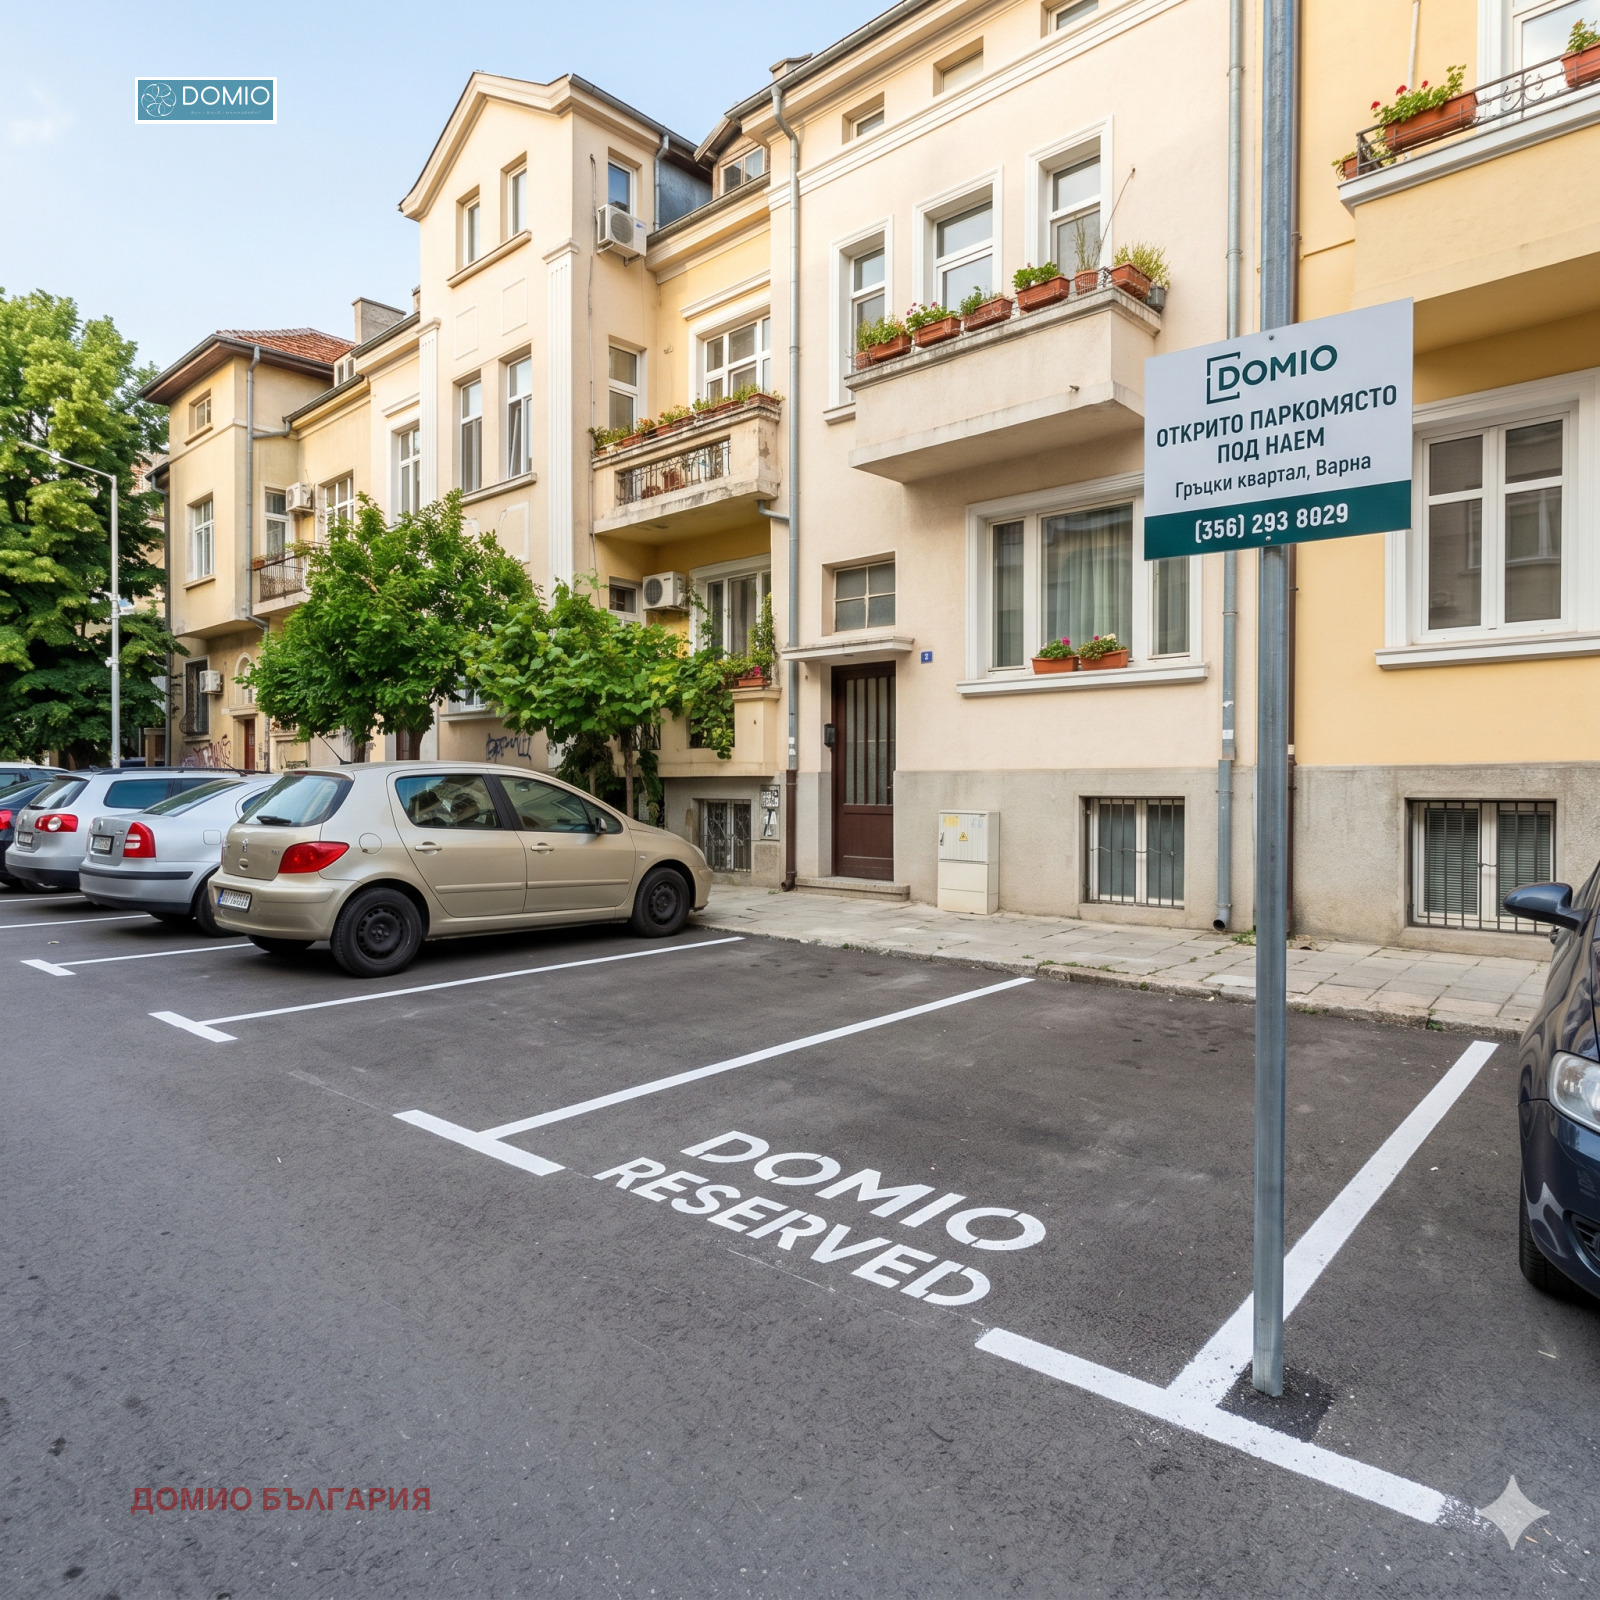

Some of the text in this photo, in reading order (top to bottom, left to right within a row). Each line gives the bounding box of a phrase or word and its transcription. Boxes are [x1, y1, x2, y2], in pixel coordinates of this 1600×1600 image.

[1218, 344, 1338, 392] DOMIO
[1156, 384, 1397, 448] ОТКРИТО ПАРКОМЯСТО
[1217, 426, 1326, 464] ПОД НАЕМ
[1175, 454, 1372, 501] Гръцки квартал, Варна
[1195, 514, 1246, 544] (356)
[1251, 510, 1289, 534] 293
[680, 1130, 1047, 1251] DOMIO
[592, 1156, 991, 1307] RESERVED
